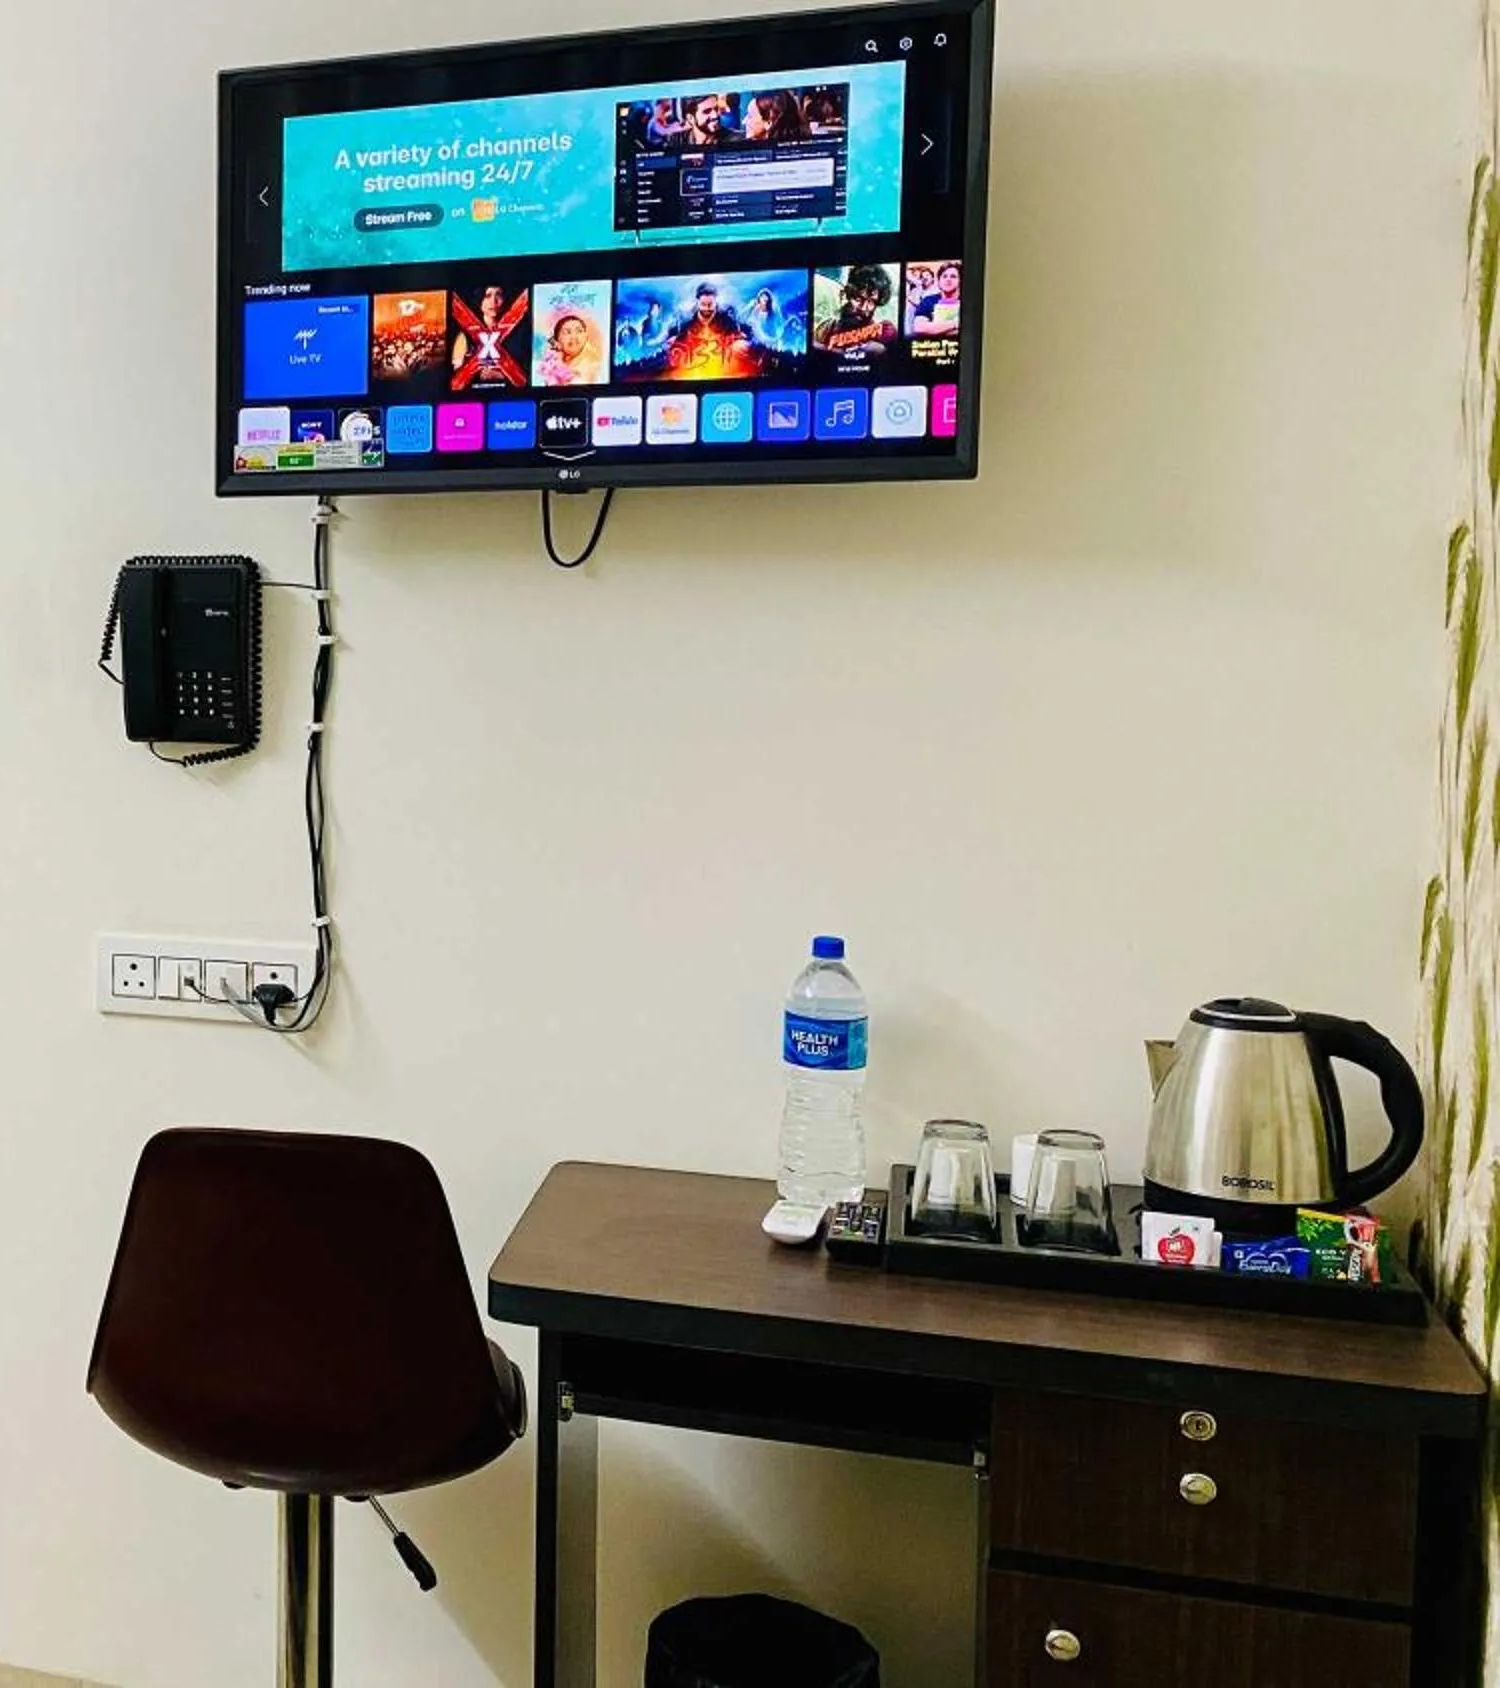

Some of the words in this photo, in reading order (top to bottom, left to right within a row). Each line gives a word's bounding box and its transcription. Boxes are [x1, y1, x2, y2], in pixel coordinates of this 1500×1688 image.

[334, 149, 350, 170] A
[356, 144, 432, 168] variety
[438, 138, 460, 160] of
[466, 131, 573, 158] channels
[363, 166, 475, 193] streaming
[481, 160, 534, 185] 24/7
[365, 211, 405, 226] Stream
[407, 210, 432, 223] Free
[451, 207, 465, 218] on
[244, 284, 287, 296] Trending
[289, 355, 308, 365] Live
[309, 353, 322, 364] TV
[791, 1029, 839, 1046] HEALTH
[797, 1042, 829, 1057] PLUS
